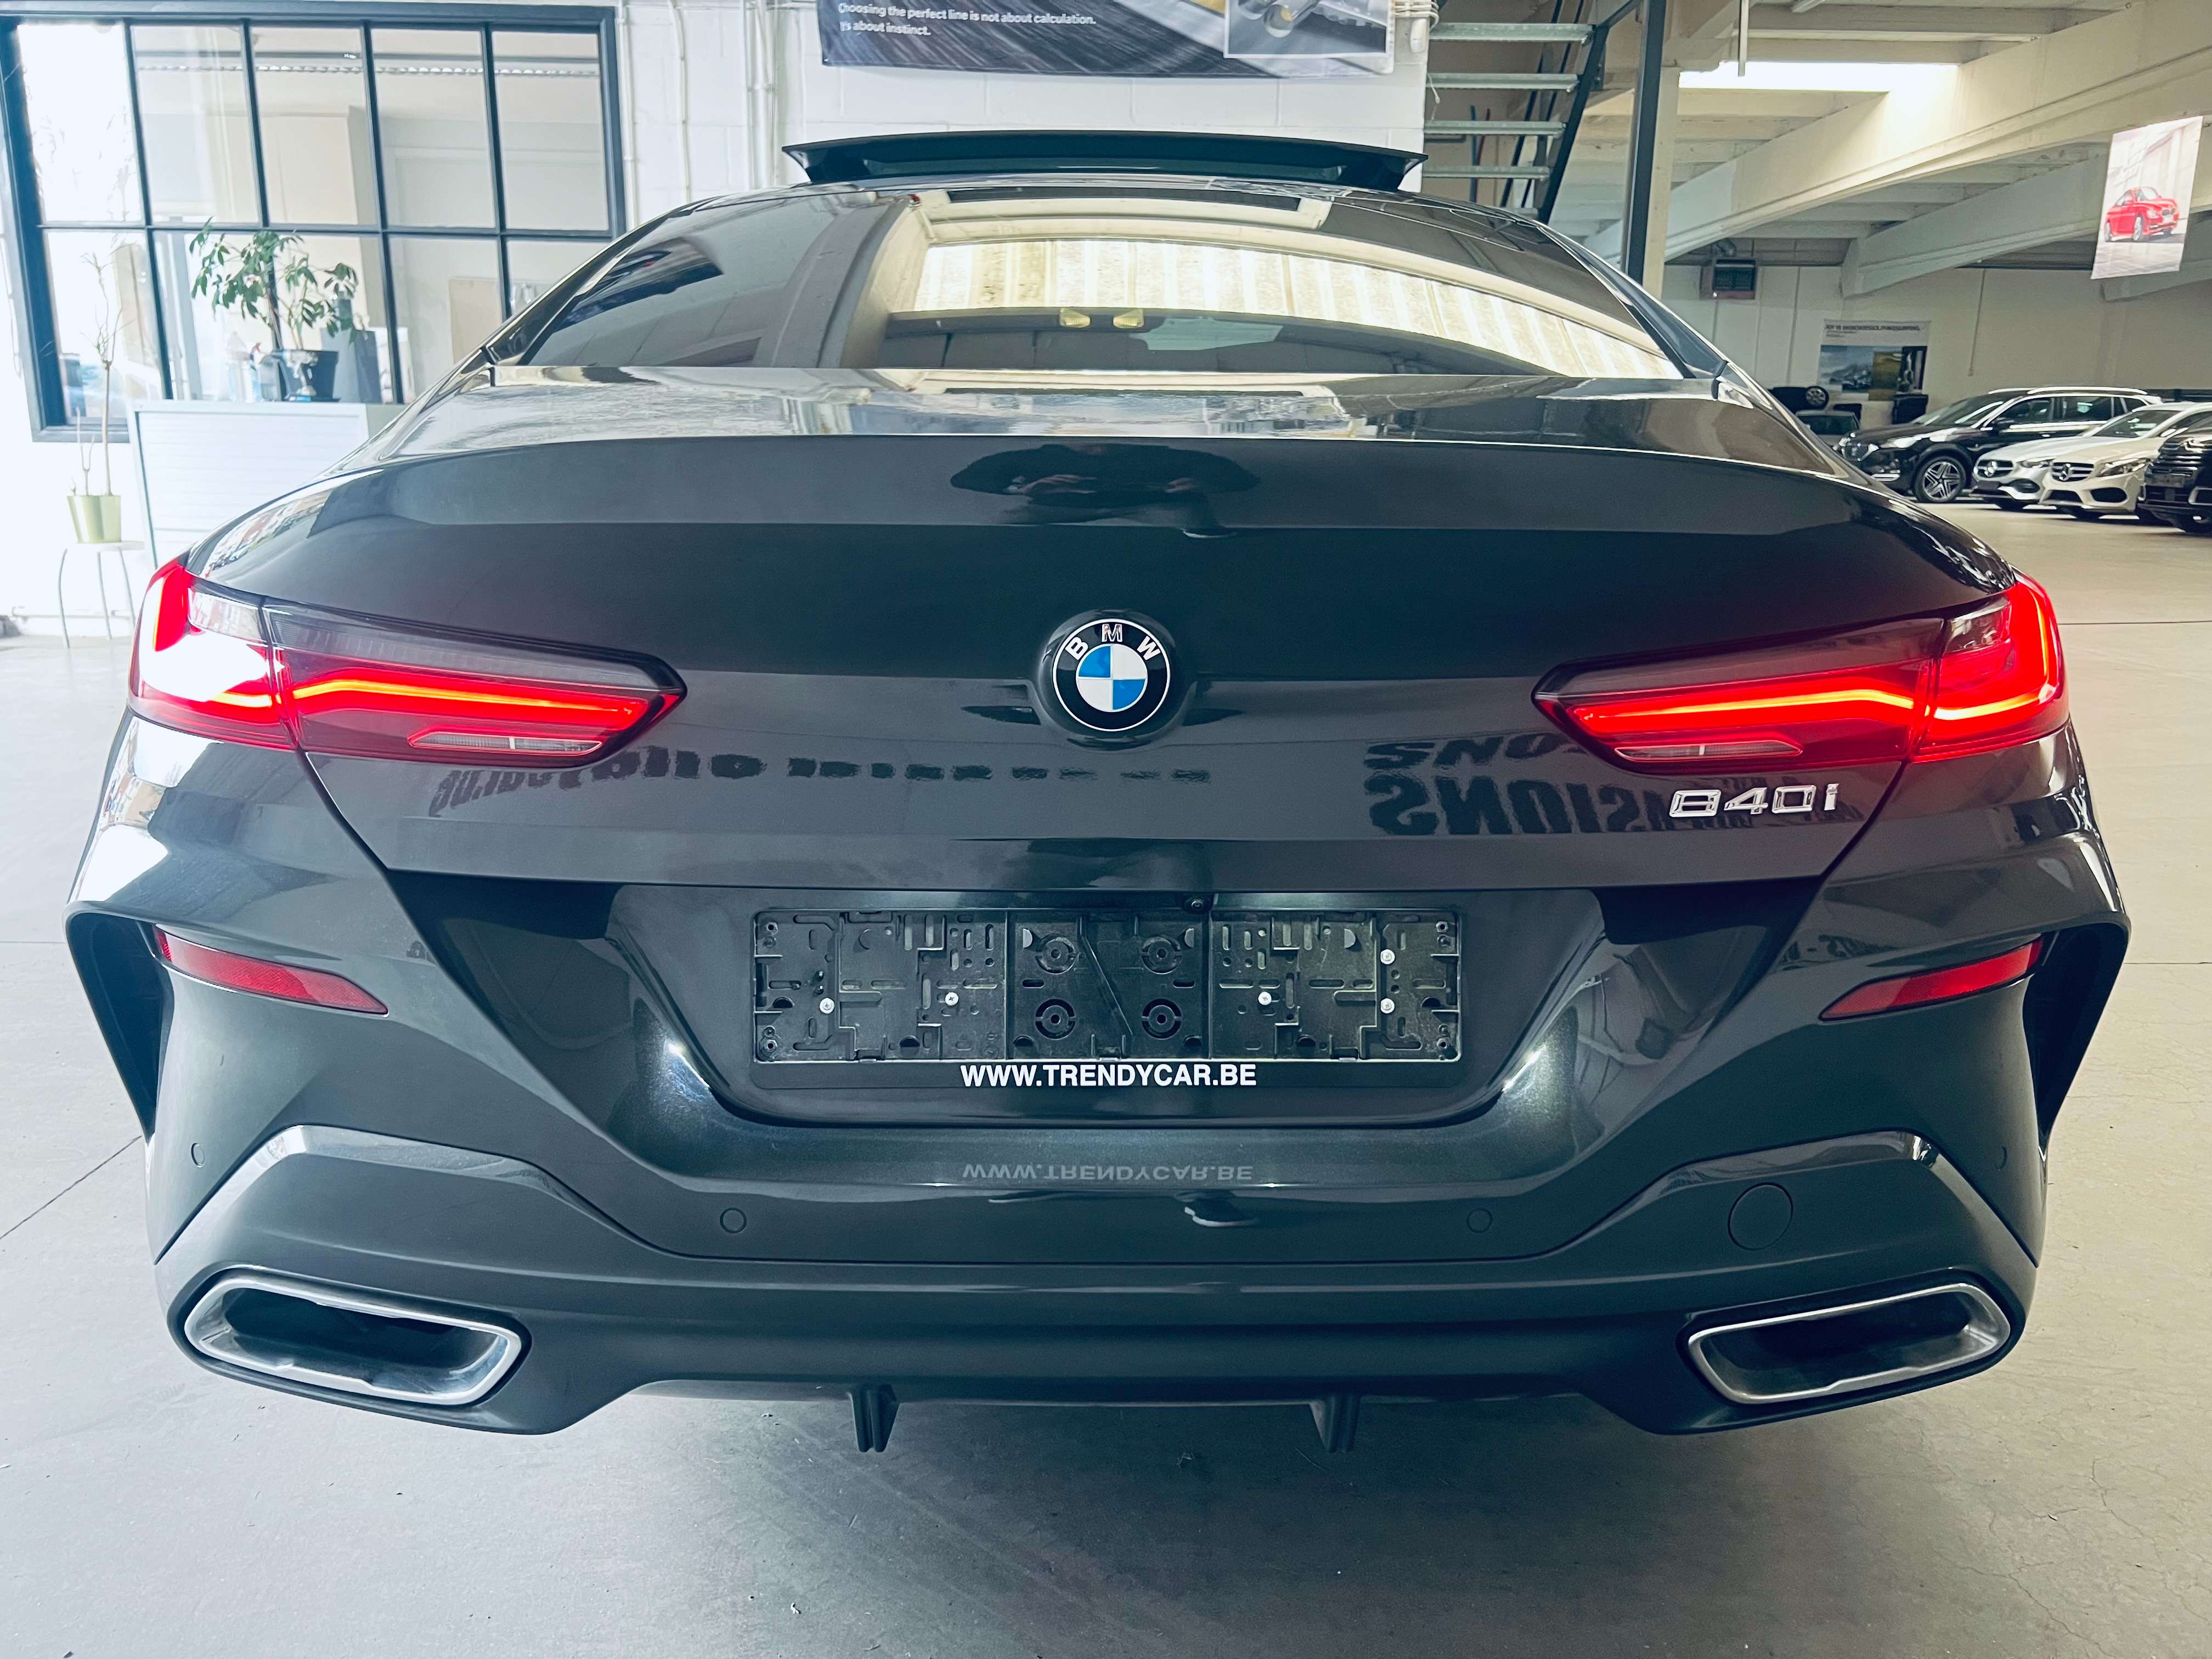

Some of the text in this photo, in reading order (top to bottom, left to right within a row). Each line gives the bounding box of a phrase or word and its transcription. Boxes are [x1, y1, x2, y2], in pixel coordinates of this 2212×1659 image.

[838, 3, 1097, 24] Choosing the perfect line is not about calculation.
[839, 20, 931, 35] It's about instinct.
[1065, 624, 1161, 661] BMW
[1669, 783, 1839, 817] 840i
[960, 1064, 1257, 1087] WWW.TRENDYCAR.BE
